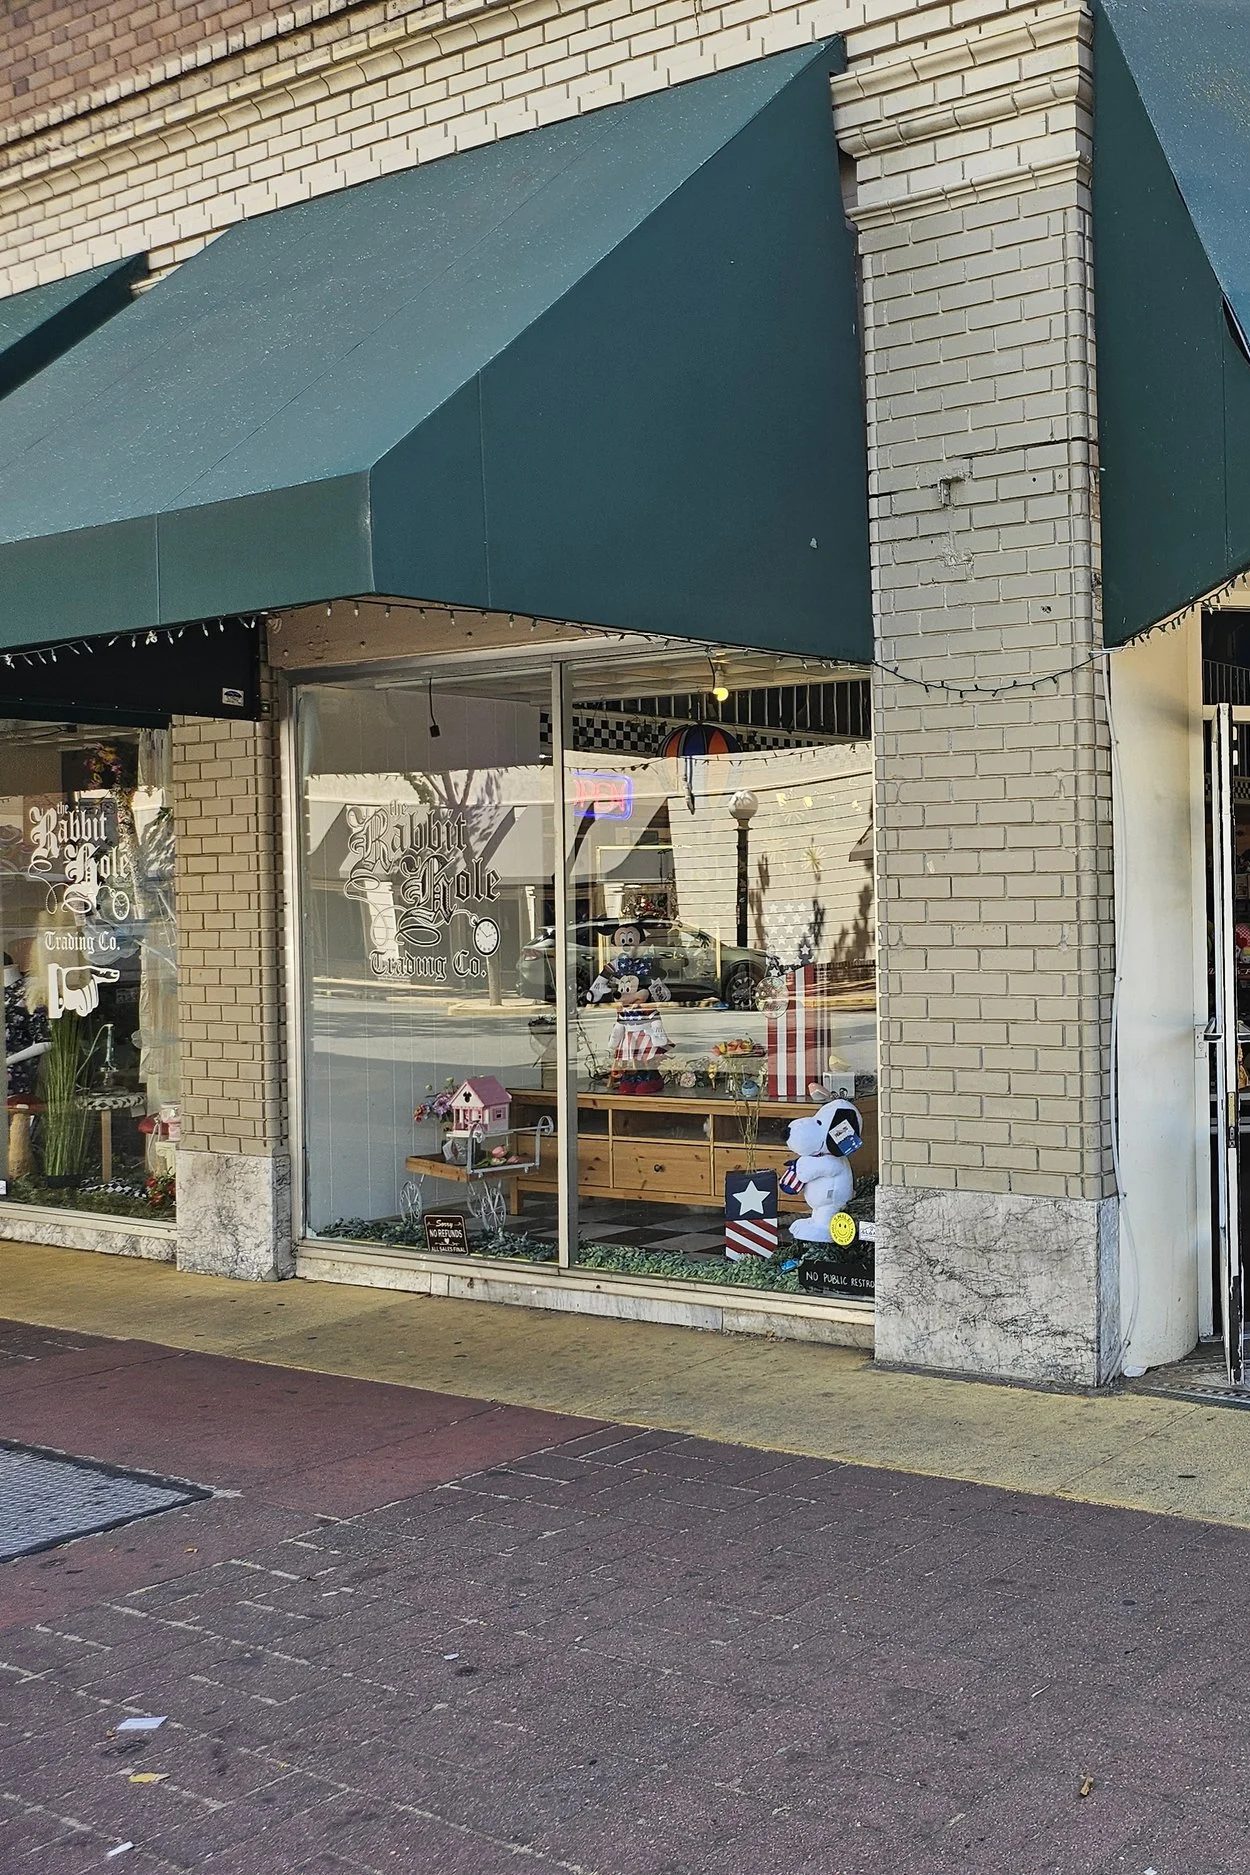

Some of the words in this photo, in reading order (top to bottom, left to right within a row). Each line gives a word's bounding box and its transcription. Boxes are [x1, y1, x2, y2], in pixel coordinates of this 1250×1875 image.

[57, 801, 69, 817] the
[389, 799, 407, 816] the
[28, 806, 108, 861] Rabbit
[346, 806, 468, 875] Rabbit
[64, 842, 131, 902] Hole
[400, 854, 502, 924] Hole
[44, 931, 95, 953] Trading
[98, 931, 121, 951] Co.
[370, 950, 448, 981] Trading
[452, 950, 487, 978] Co.
[429, 1229, 438, 1238] NO
[438, 1229, 462, 1238] REFUNDS
[435, 1219, 453, 1229] Sorry
[806, 1271, 819, 1281] NO
[823, 1273, 848, 1286] PUBLIC
